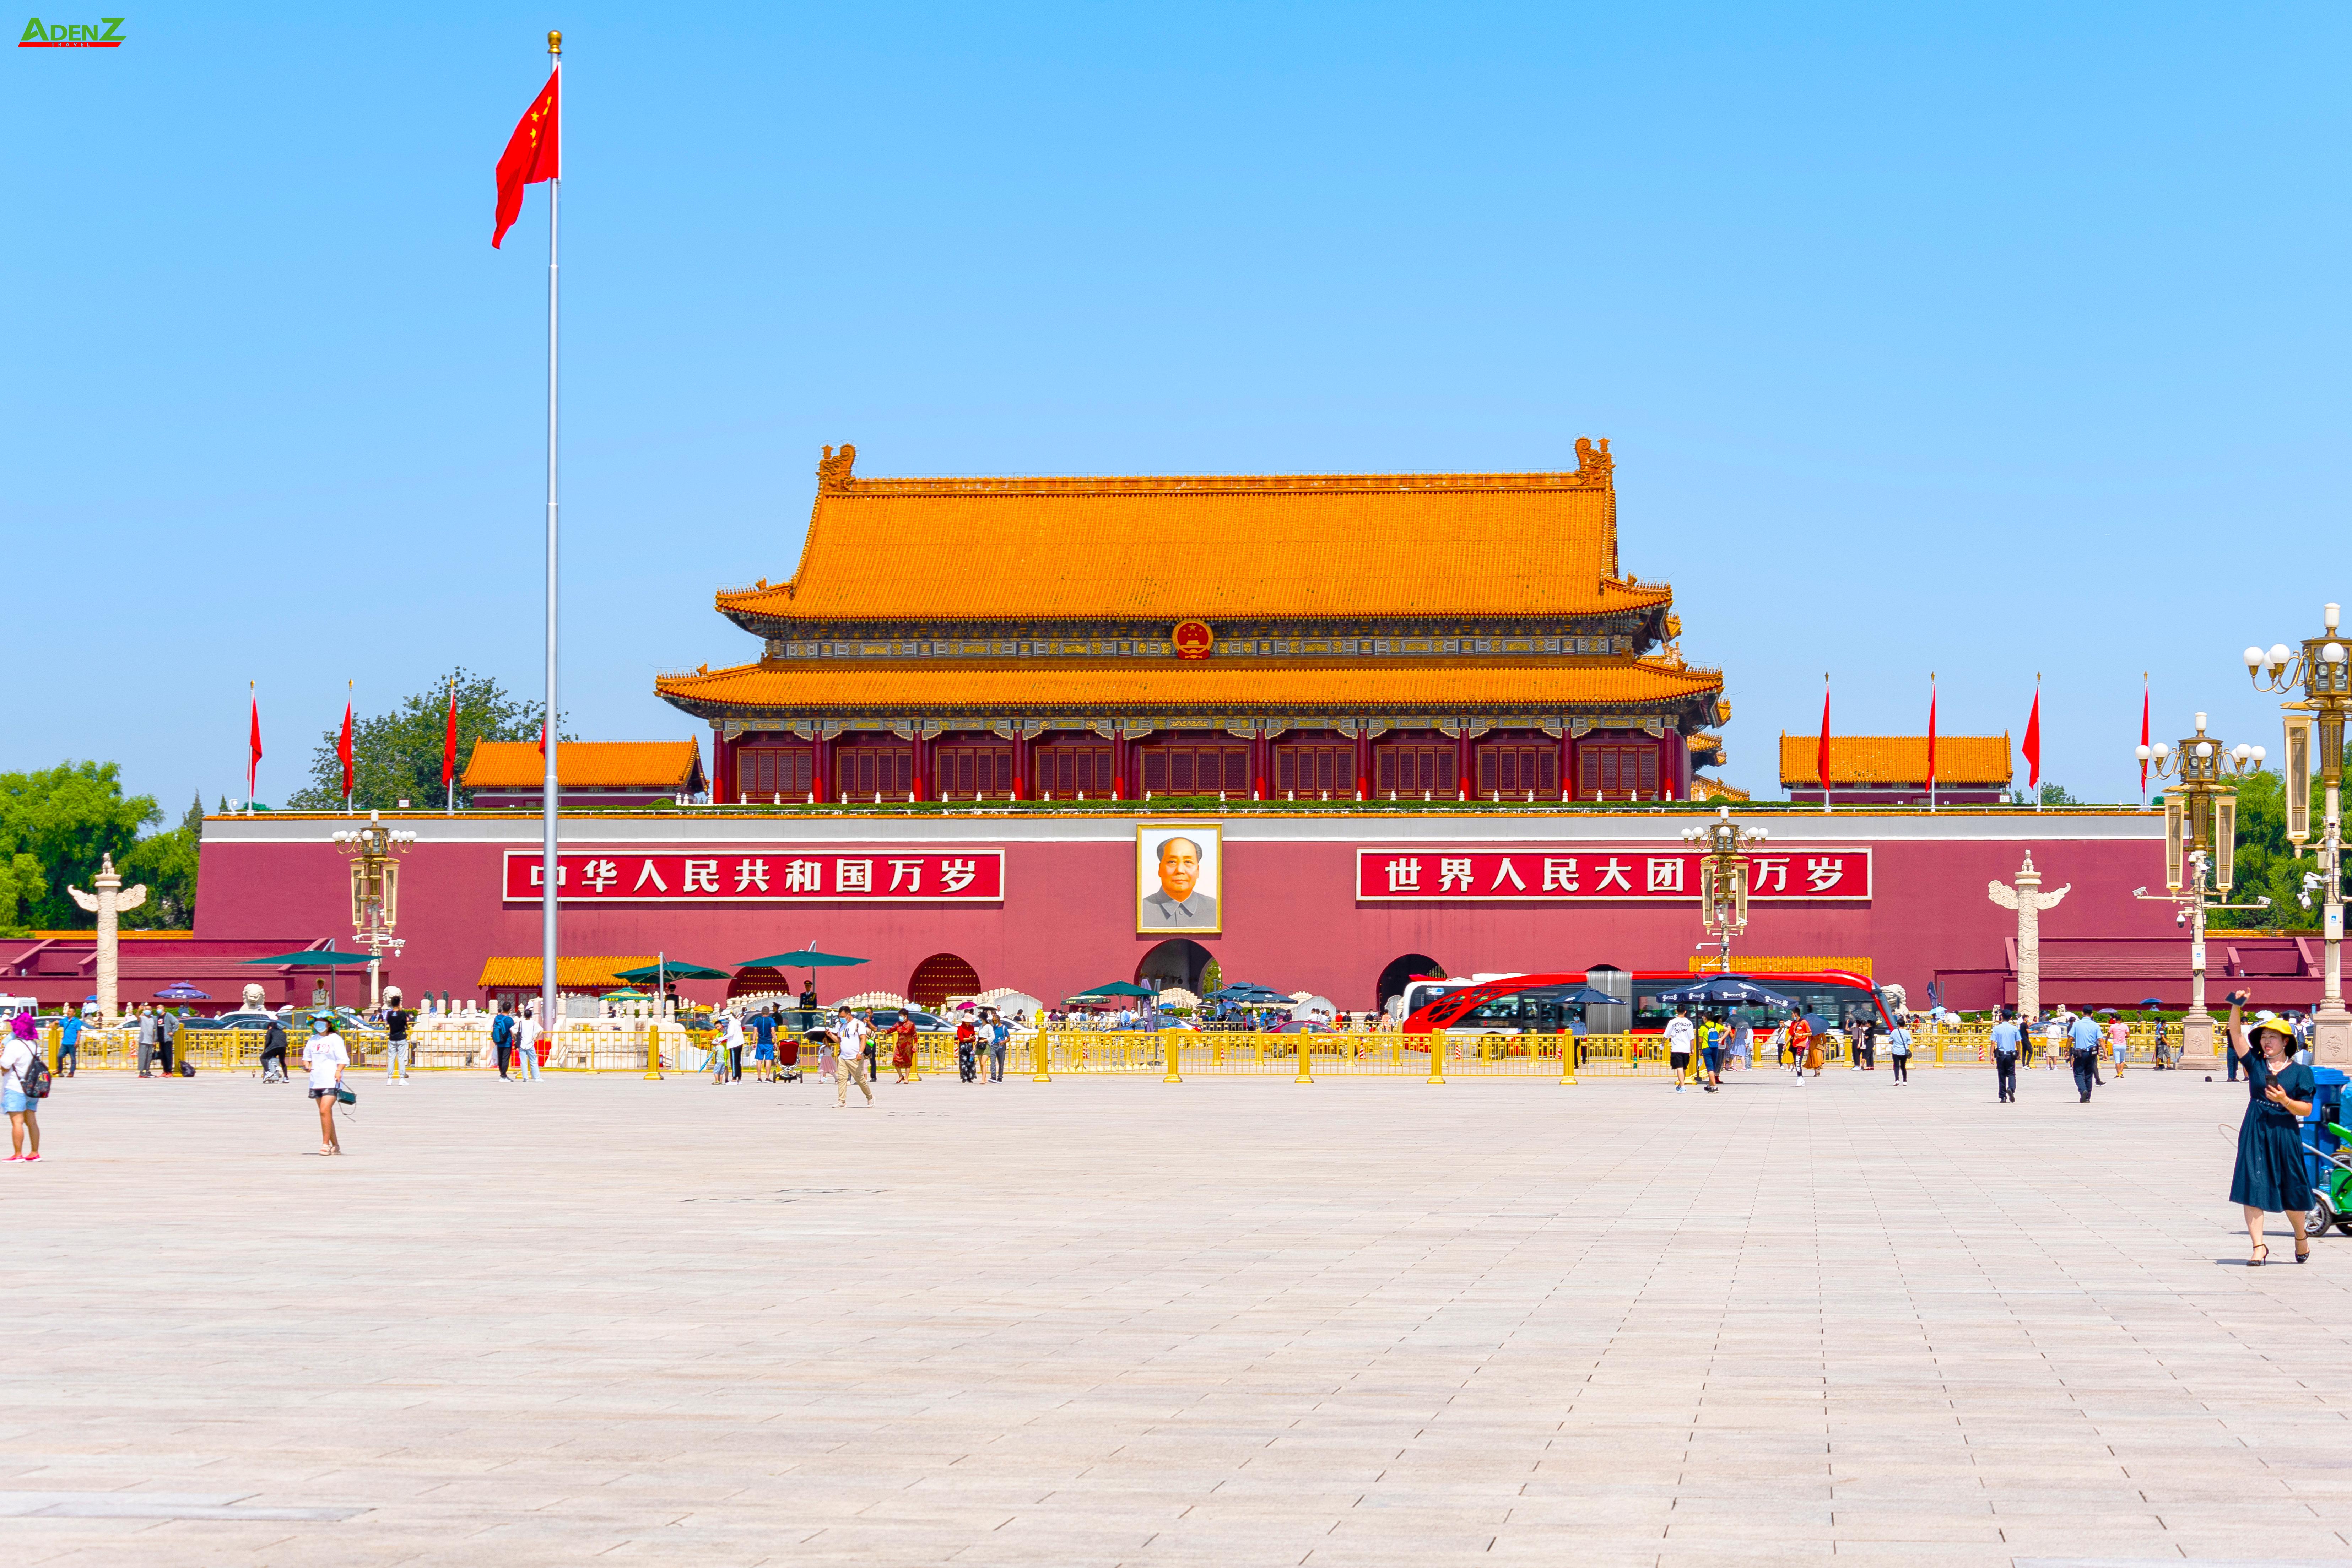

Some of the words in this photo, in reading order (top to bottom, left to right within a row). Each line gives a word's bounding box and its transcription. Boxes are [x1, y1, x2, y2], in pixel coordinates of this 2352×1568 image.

[1385, 857, 1844, 892] 世界人民大团万岁
